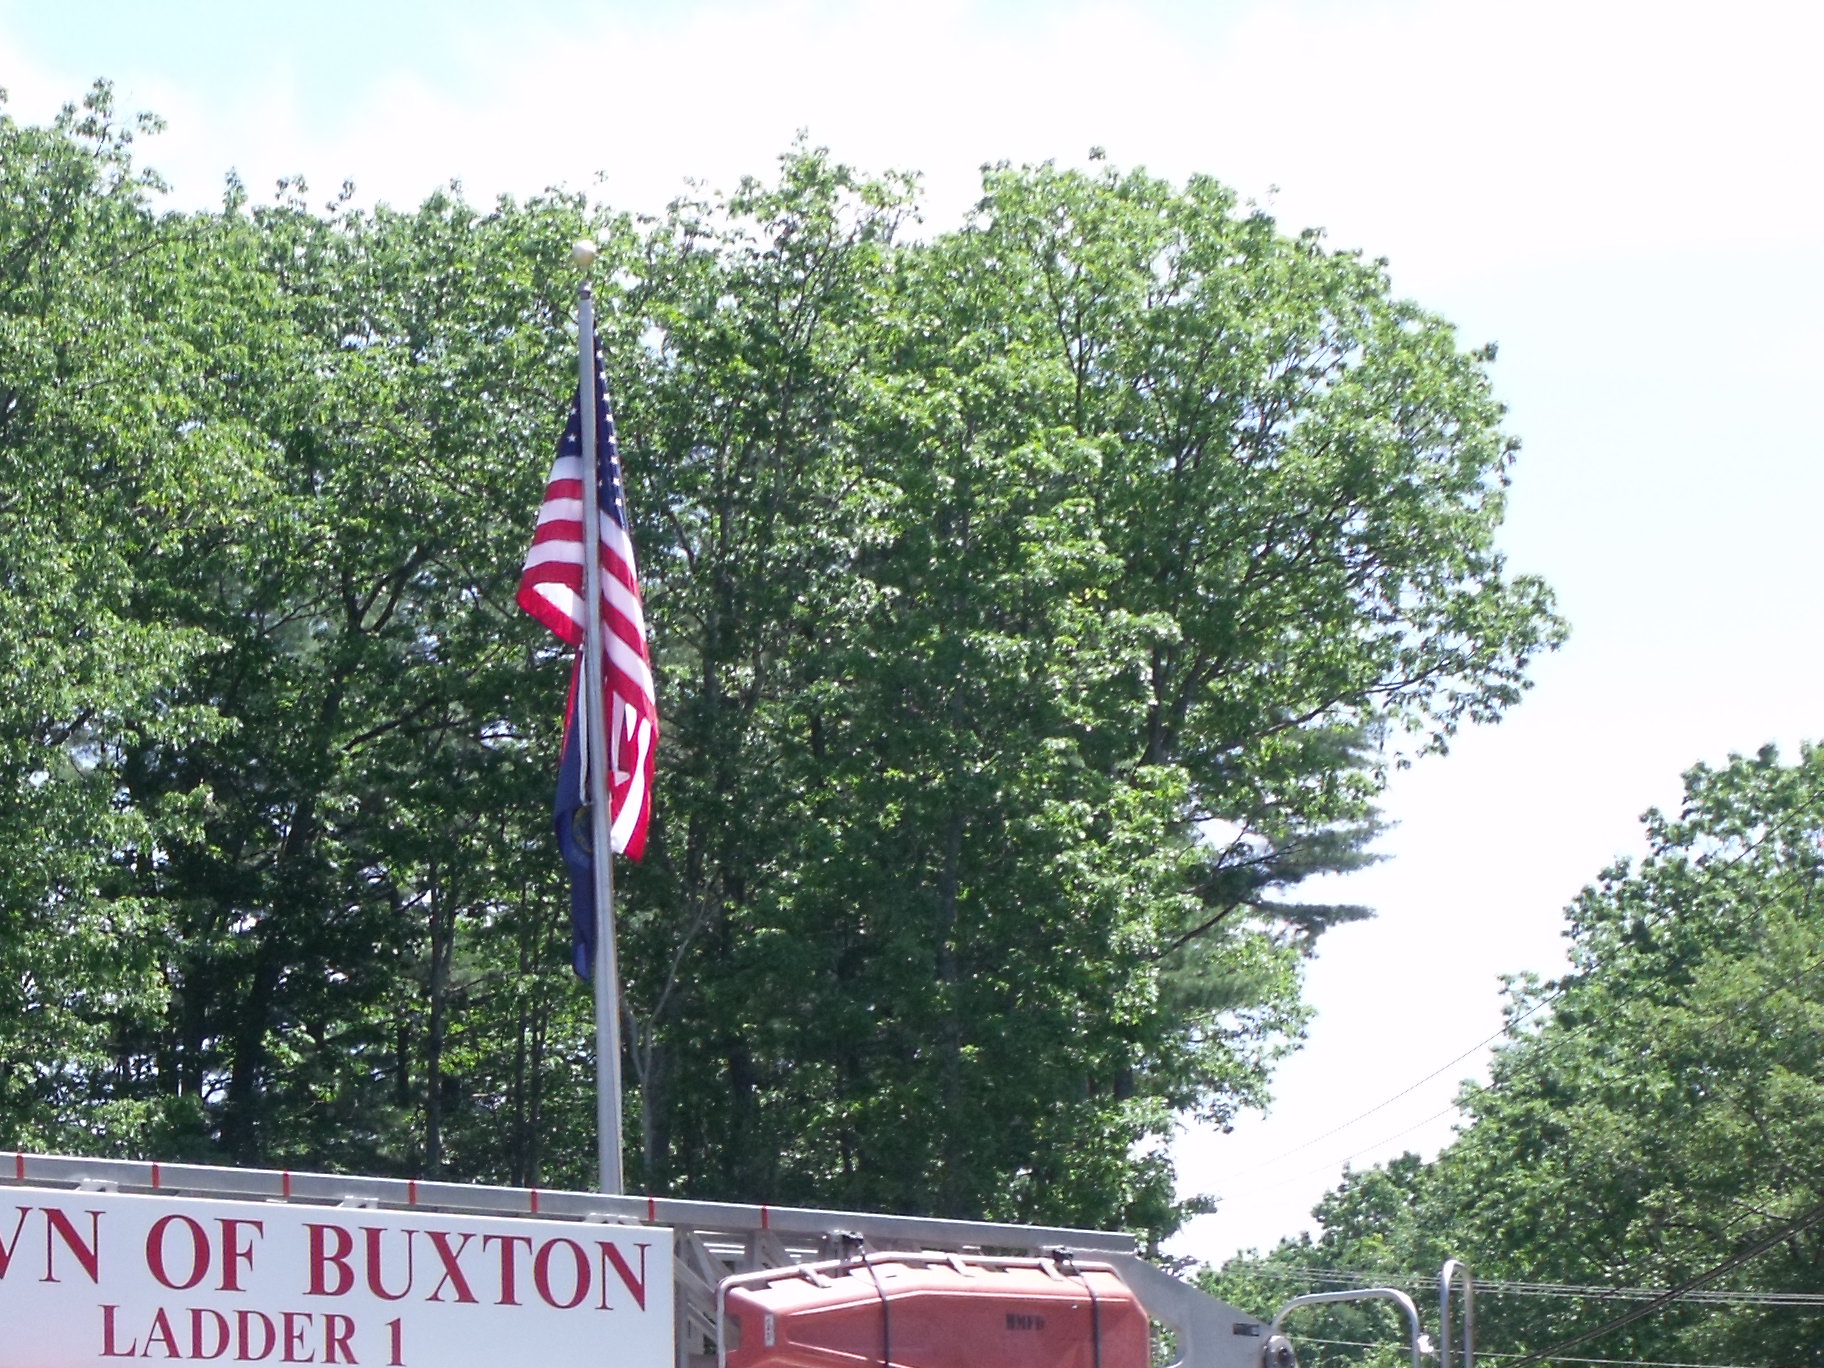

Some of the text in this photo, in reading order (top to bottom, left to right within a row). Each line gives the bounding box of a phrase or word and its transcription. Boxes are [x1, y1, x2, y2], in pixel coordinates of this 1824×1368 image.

[146, 1214, 264, 1292] OF
[303, 1223, 651, 1312] BUXTON
[99, 1304, 405, 1367] LADDER 1
